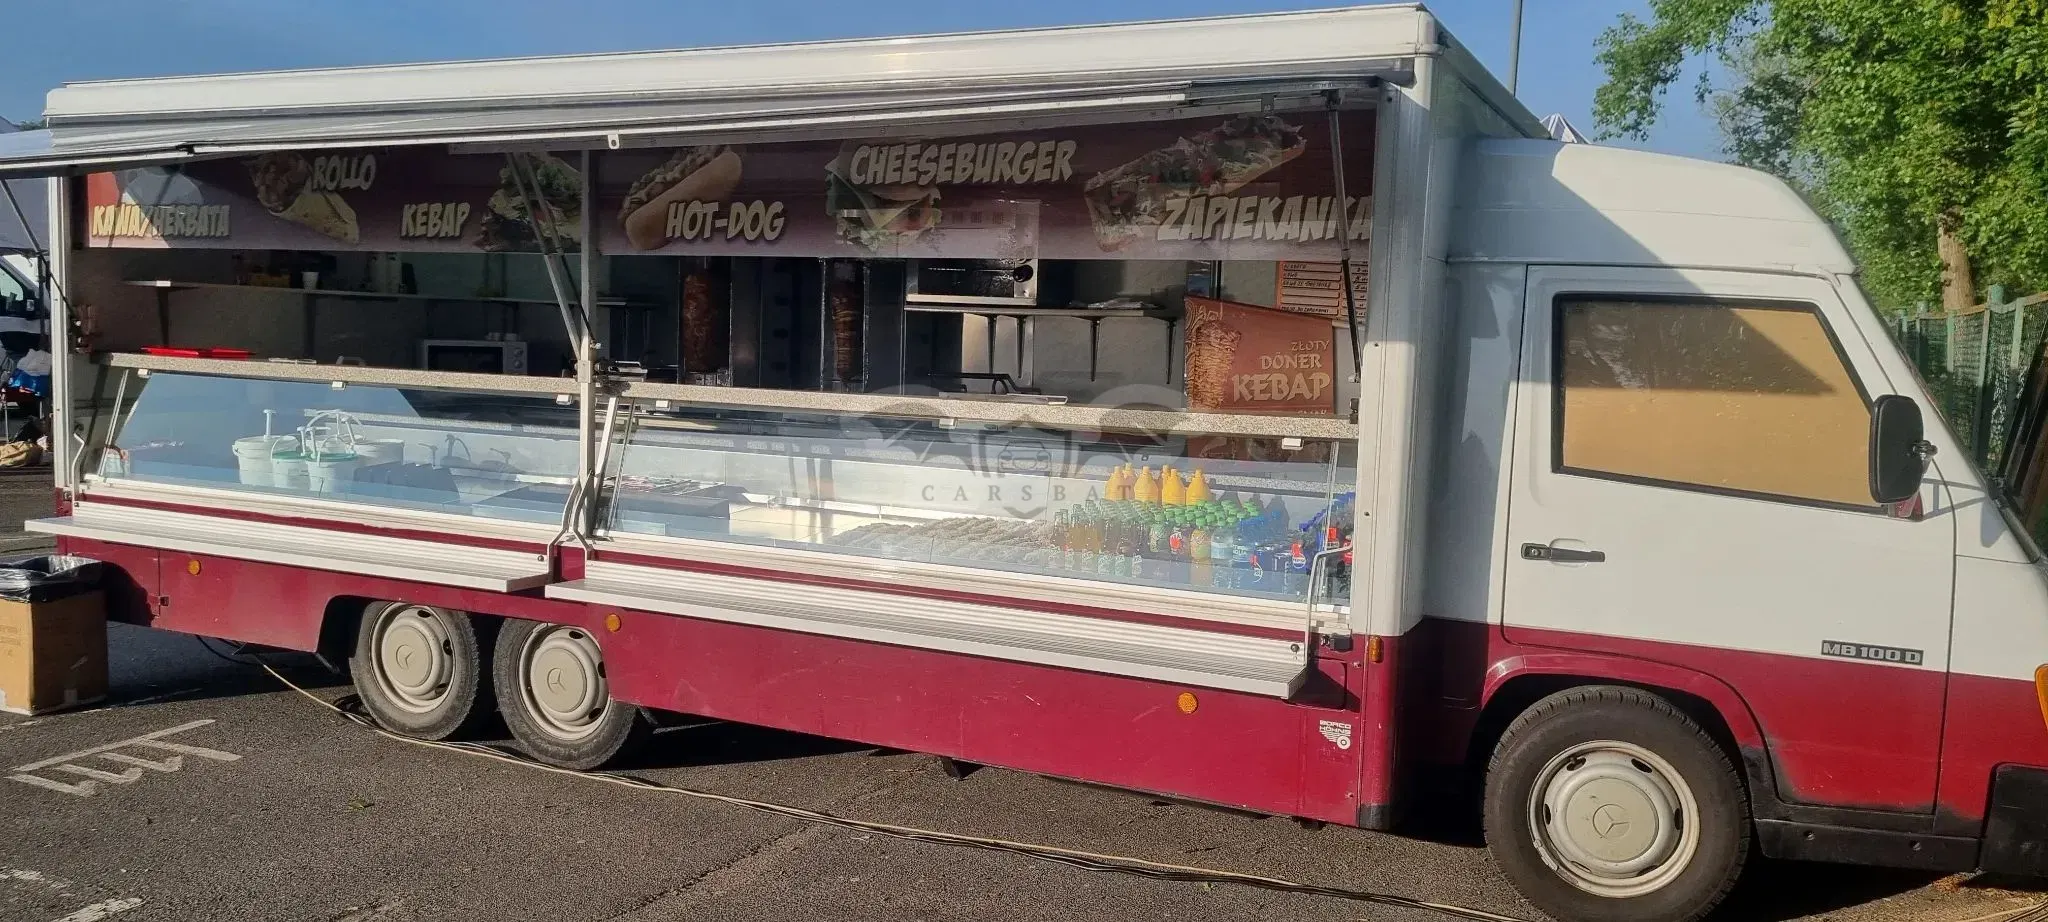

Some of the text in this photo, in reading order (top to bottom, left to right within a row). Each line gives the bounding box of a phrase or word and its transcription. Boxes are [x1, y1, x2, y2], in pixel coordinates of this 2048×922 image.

[312, 154, 377, 191] ROLLO
[851, 140, 1078, 185] CHEESEBURGER
[400, 202, 471, 238] KEBAP
[665, 200, 785, 241] HOT-DOG
[1260, 352, 1322, 370] DÖNER
[1290, 340, 1330, 352] ZŁOTY
[1231, 372, 1331, 402] KEBAP
[1822, 642, 1921, 664] MB 100 D
